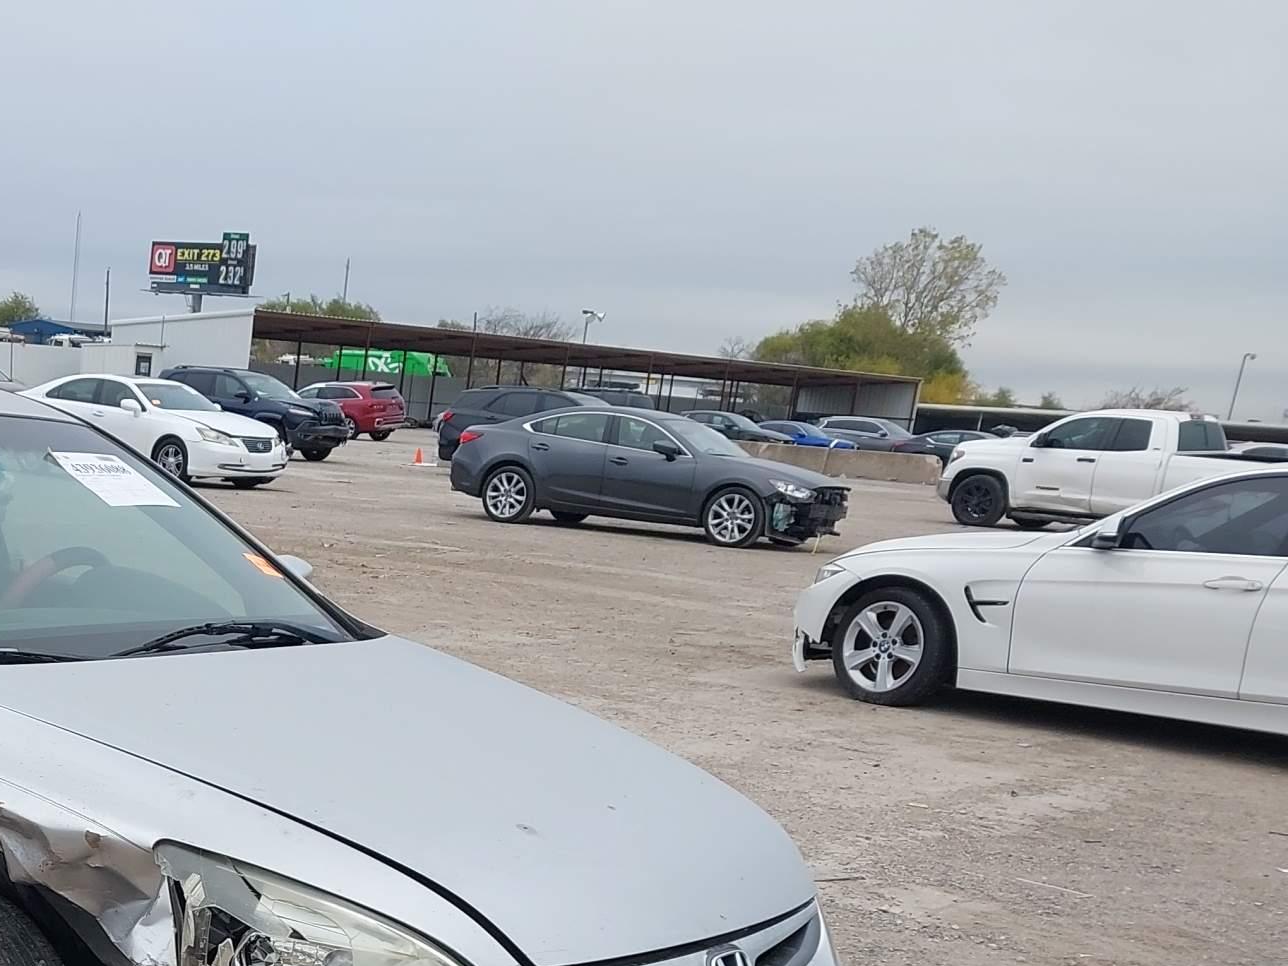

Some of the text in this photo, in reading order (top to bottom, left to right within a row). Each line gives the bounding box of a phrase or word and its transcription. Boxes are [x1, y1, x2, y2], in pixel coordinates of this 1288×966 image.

[155, 248, 172, 267] QT
[176, 248, 221, 261] EXIT 273
